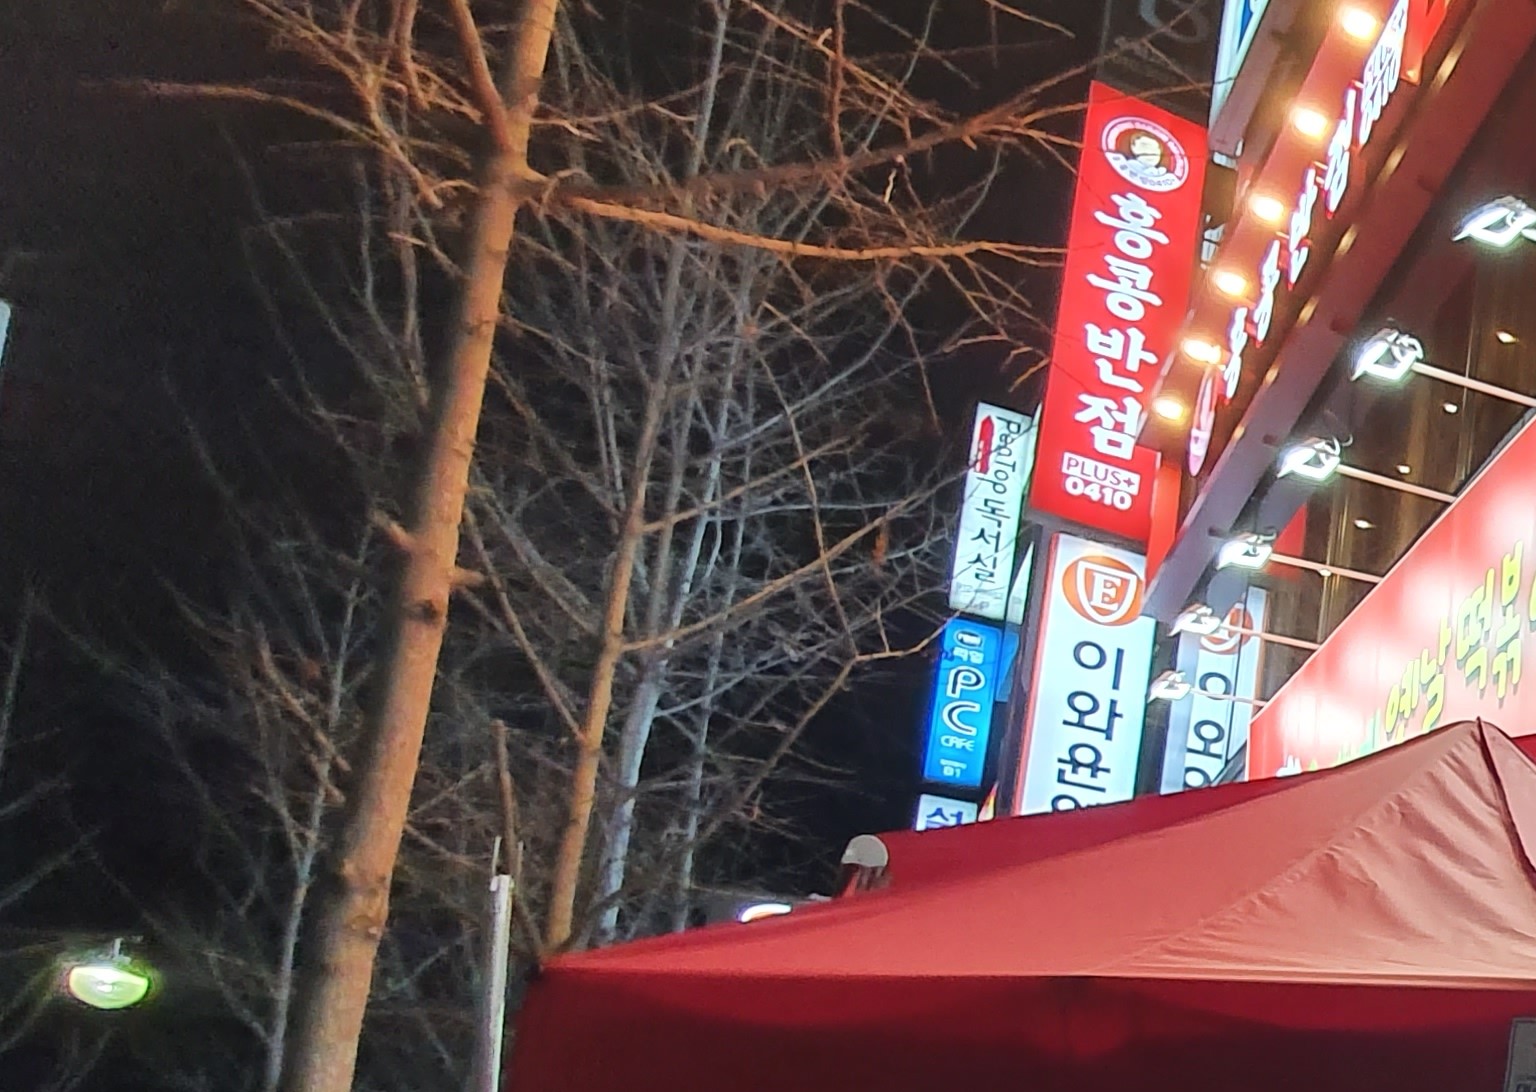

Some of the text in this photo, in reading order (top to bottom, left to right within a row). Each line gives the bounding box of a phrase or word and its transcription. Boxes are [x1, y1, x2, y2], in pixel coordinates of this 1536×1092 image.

[1074, 192, 1170, 460] 홍콩반점
[967, 497, 1011, 584] 독서실
[1064, 475, 1133, 511] 0410
[1051, 641, 1125, 813] 이와윤
